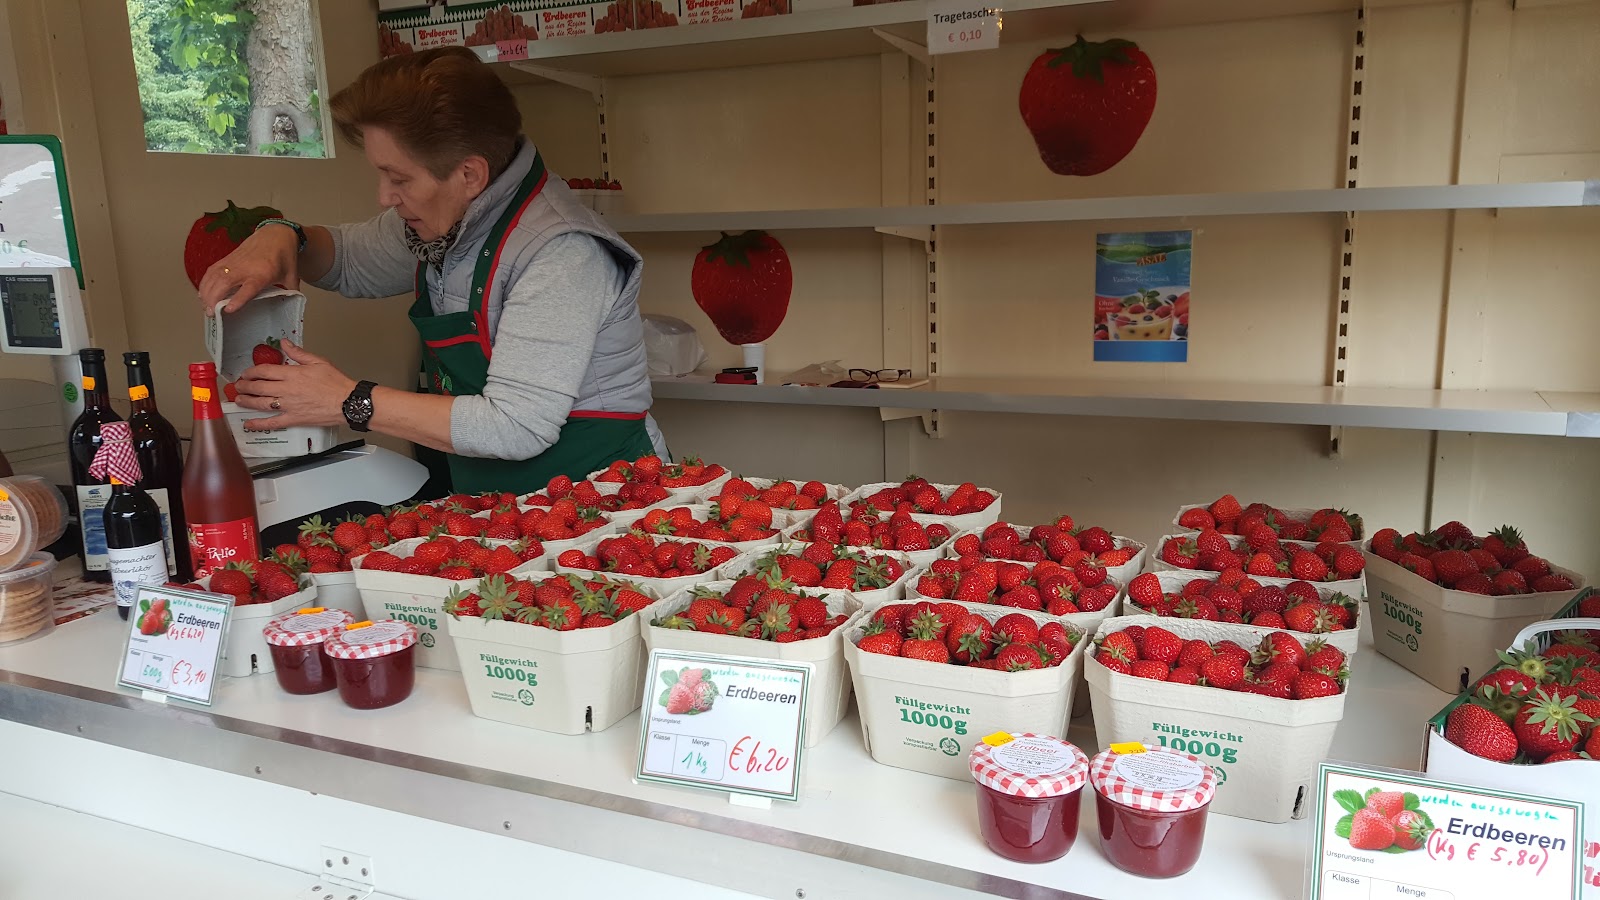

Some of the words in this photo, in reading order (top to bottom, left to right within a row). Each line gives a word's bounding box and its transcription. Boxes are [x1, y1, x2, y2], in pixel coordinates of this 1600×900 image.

[542, 11, 587, 23] Erdbeeren
[933, 7, 996, 24] Tragetasche
[418, 28, 458, 40] Erdbeeren
[948, 32, 955, 43] €
[960, 29, 982, 42] 0,10
[384, 602, 437, 614] Füllgewicht
[1381, 591, 1424, 618] Füllgewicht
[177, 612, 221, 630] Erdbeeren
[389, 612, 438, 630] 1000g
[1383, 602, 1423, 635] 1000g
[480, 653, 538, 668] Füllgewicht
[484, 664, 538, 687] 1000g
[725, 684, 797, 705] Erdbeeren
[894, 695, 971, 715] Füllgewicht
[899, 708, 968, 736] 1000g
[653, 733, 671, 742] Klasse
[691, 738, 710, 747] Menge
[1152, 722, 1244, 743] Füllgewicht
[1011, 743, 1060, 754] Erdbeer
[1157, 735, 1238, 764] 1000g
[1447, 817, 1567, 852] Erdbeeren
[1326, 849, 1375, 865] Ursprungsland
[1467, 842, 1481, 861] €
[1331, 873, 1361, 885] Klasse
[1396, 884, 1427, 899] Menge
